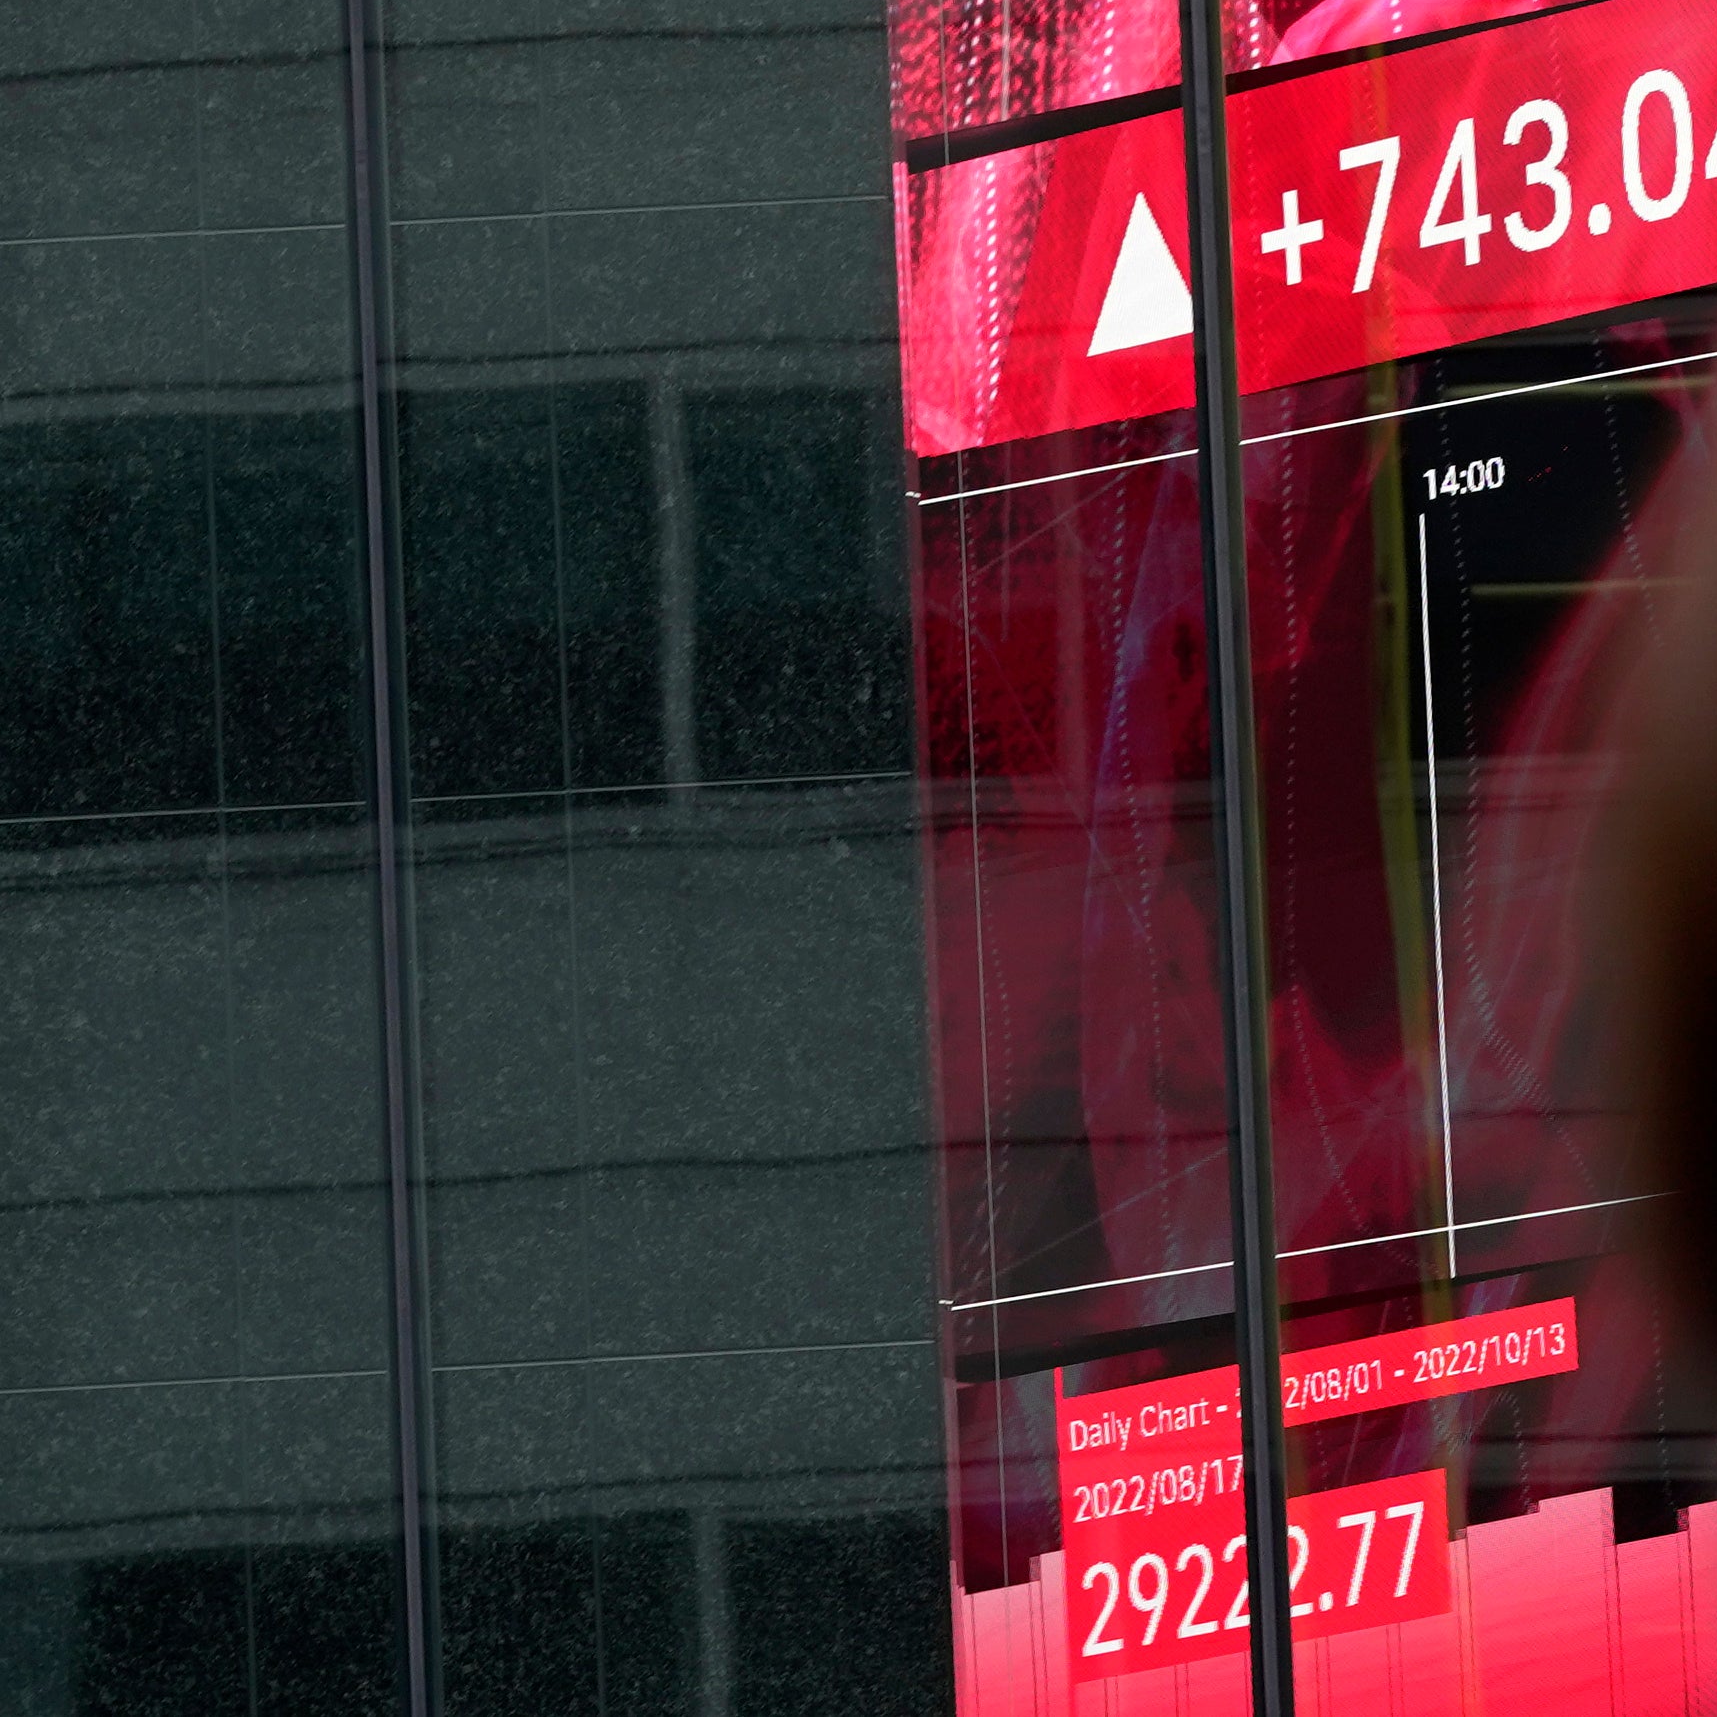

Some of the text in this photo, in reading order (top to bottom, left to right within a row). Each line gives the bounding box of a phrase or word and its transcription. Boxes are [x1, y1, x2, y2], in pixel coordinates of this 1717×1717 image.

[1423, 456, 1506, 500] 14:00
[1069, 1411, 1132, 1452] Daily
[1139, 1398, 1210, 1439] Chart
[1235, 1360, 1382, 1419] 2/08/01
[1413, 1323, 1566, 1384] 2022/10/13
[1072, 1453, 1244, 1524] 2022/08/17
[1081, 1500, 1426, 1658] 29222.77
